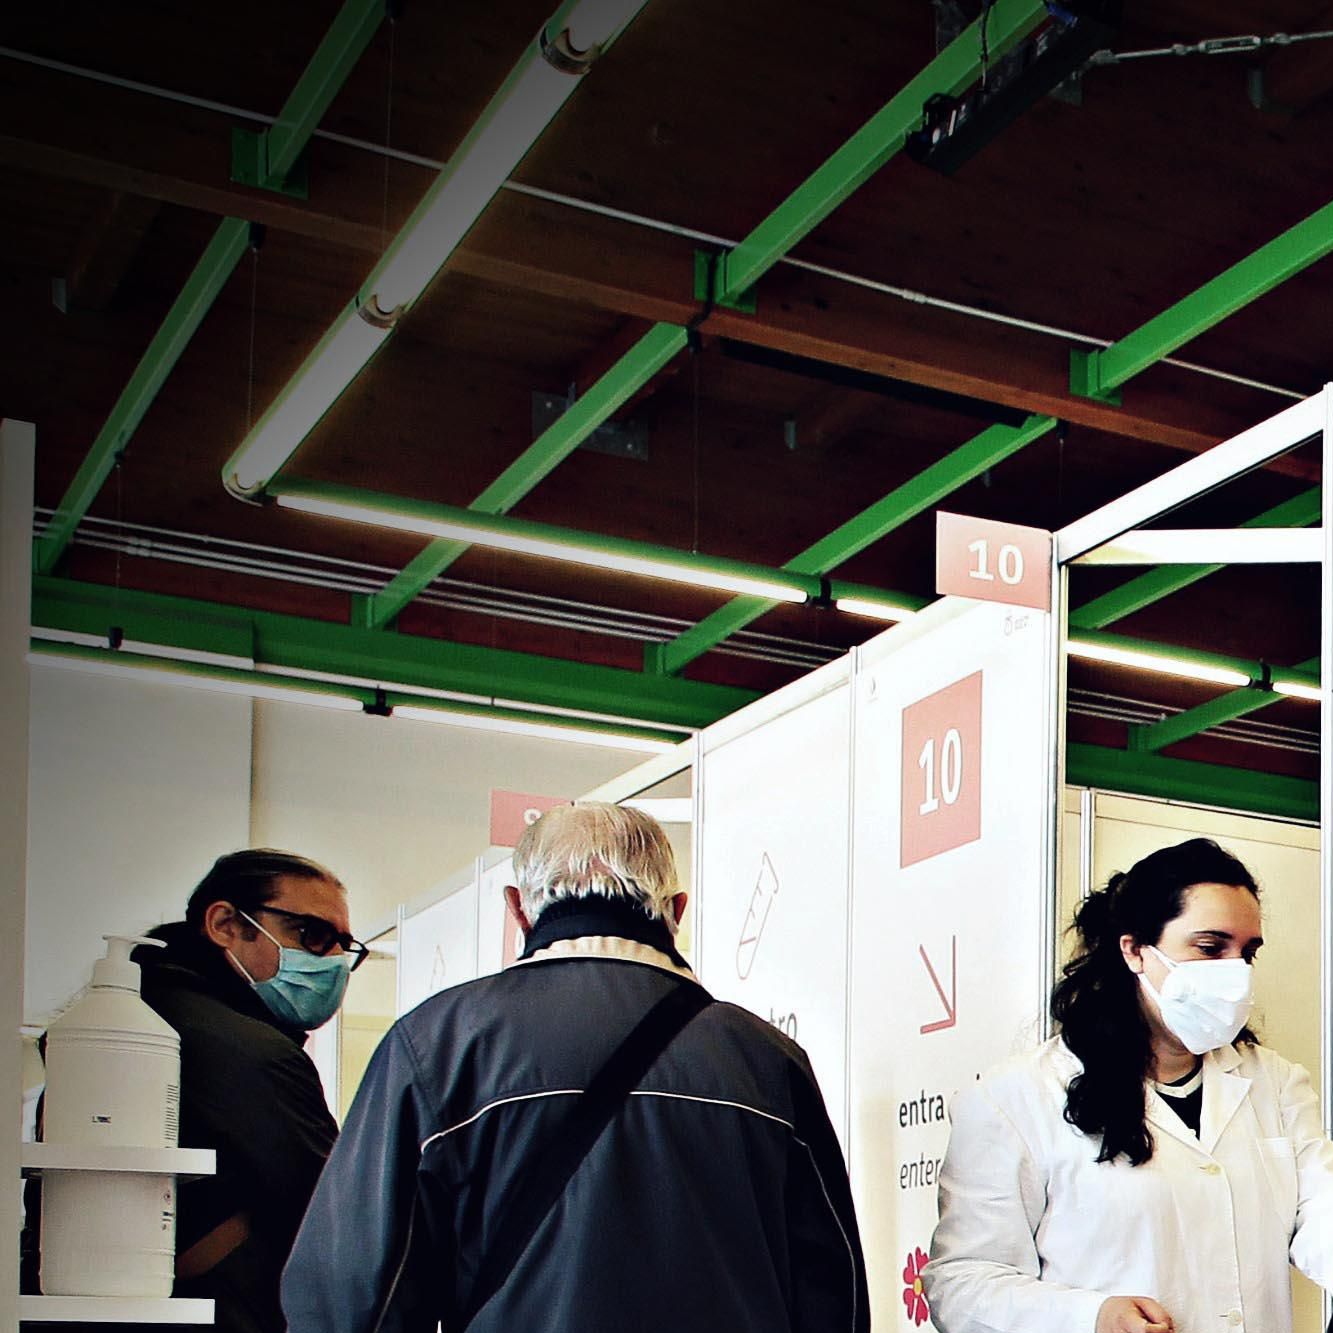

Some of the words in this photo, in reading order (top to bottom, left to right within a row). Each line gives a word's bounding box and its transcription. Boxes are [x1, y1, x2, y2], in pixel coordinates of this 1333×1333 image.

[967, 538, 1024, 584] 10
[918, 727, 962, 816] 10
[899, 1089, 945, 1128] entra
[900, 1152, 942, 1189] enter
